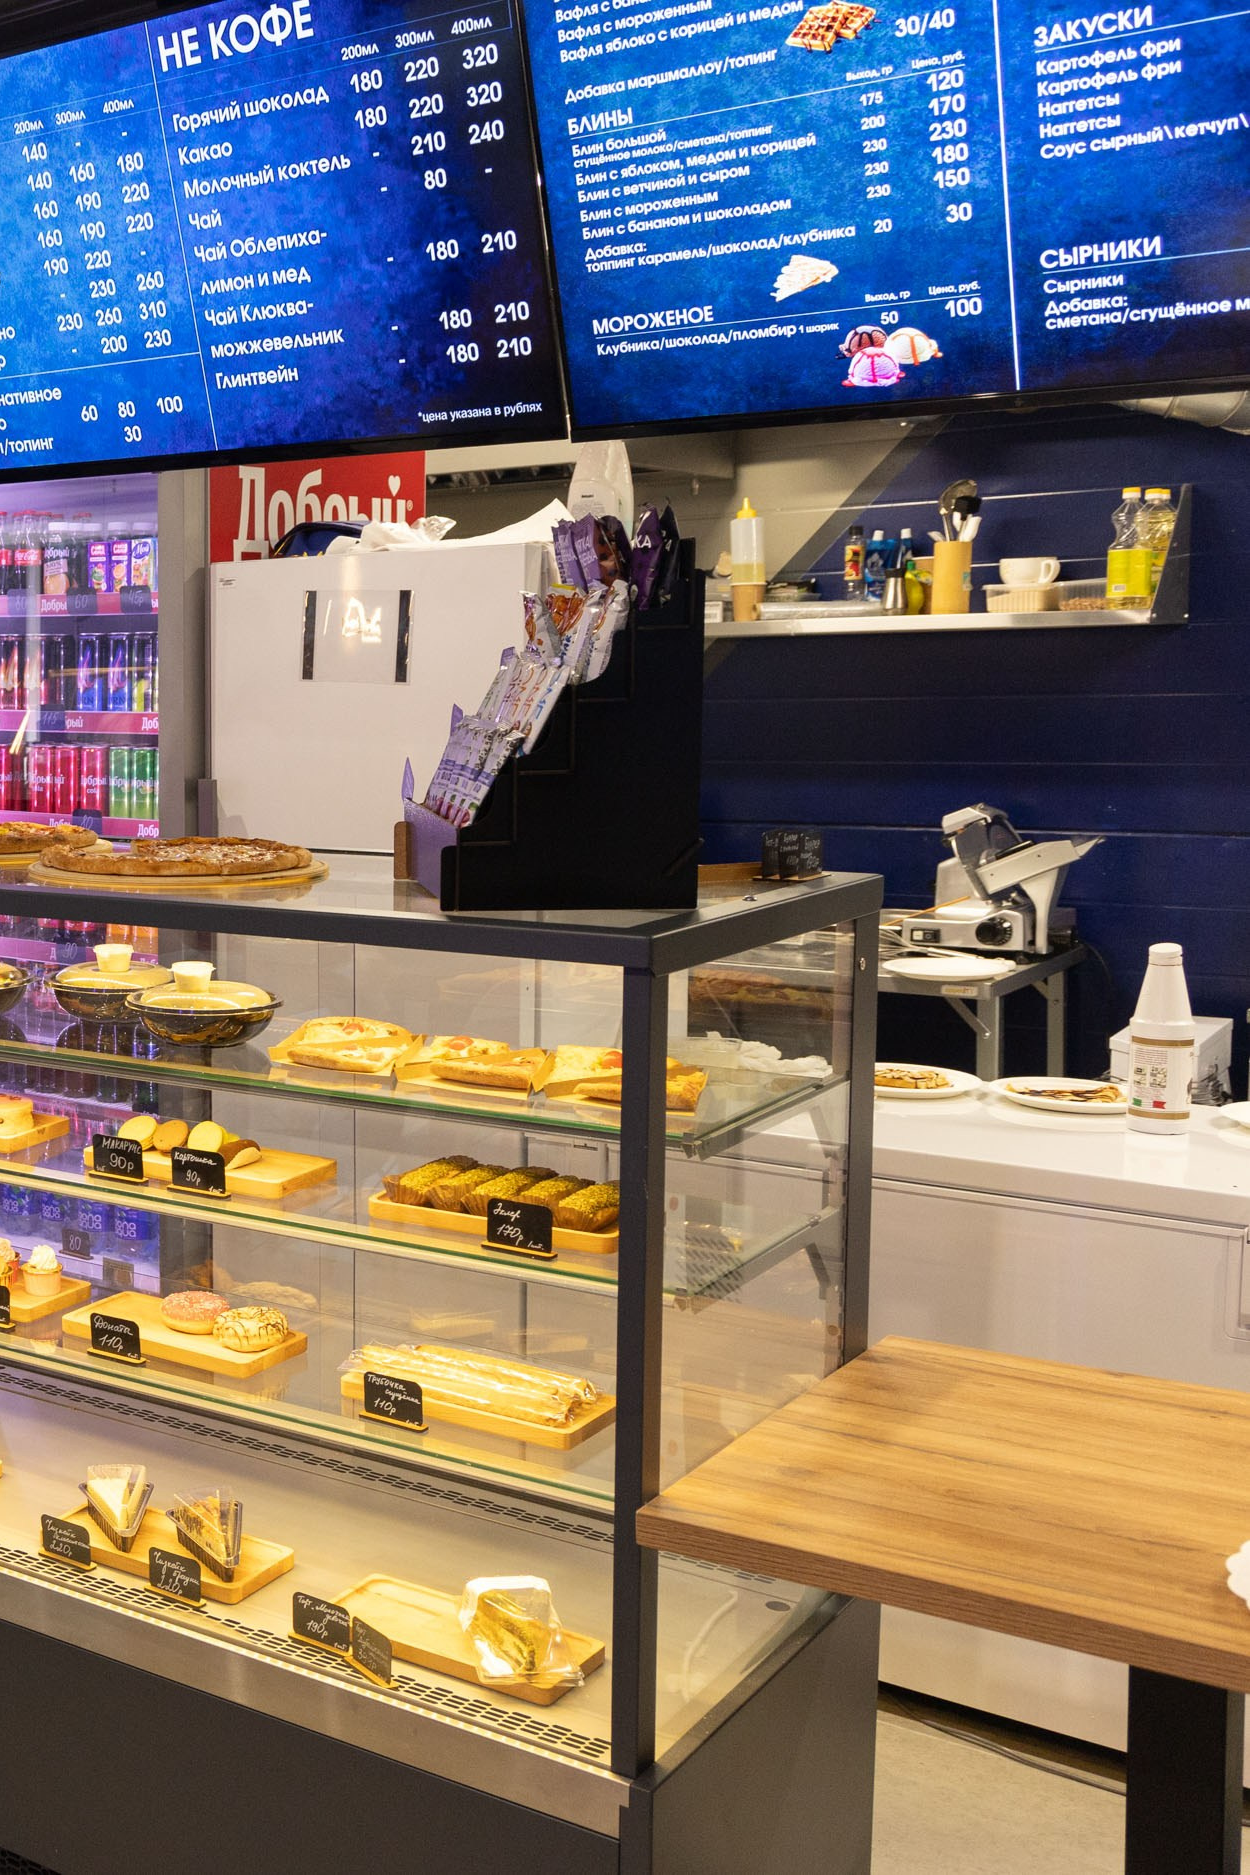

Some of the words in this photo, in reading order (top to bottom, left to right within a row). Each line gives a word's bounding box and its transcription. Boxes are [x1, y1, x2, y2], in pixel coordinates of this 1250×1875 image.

[157, 27, 202, 73] НЕ
[207, 0, 314, 60] КОФЕ
[340, 43, 380, 61] 200мл
[395, 30, 435, 49] 300мл
[450, 16, 493, 35] 400мл
[557, 23, 601, 43] Вафля
[602, 21, 613, 33] с
[615, 1, 712, 30] мороженным
[1033, 4, 1153, 48] ЗАКУСКИ
[564, 80, 626, 105] Добавка
[627, 48, 778, 90] маршмаллоу/топинг
[894, 8, 956, 38] 30/40
[1035, 47, 1138, 76] Картофель
[1140, 37, 1181, 60] фри
[172, 100, 241, 133] Горячий
[243, 86, 330, 117] шоколад
[349, 69, 383, 93] 180
[404, 56, 440, 83] 220
[462, 43, 499, 70] 320
[1038, 92, 1121, 118] Наггетсы
[567, 107, 634, 137] БЛИНЫ
[571, 142, 604, 158] Блин
[605, 127, 667, 152] большой
[859, 90, 884, 107] 175
[926, 68, 965, 92] 120
[21, 142, 48, 163] 140
[183, 164, 275, 199] Молочный
[277, 154, 351, 181] коктель
[411, 130, 446, 156] 210
[468, 119, 505, 145] 240
[574, 149, 631, 168] сгущённое
[632, 124, 773, 158] молоко/сметана/топпинг
[1040, 141, 1087, 159] Соус
[27, 170, 53, 192] 140
[69, 161, 96, 184] 160
[116, 151, 144, 174] 180
[579, 208, 612, 223] Блин
[613, 206, 623, 217] с
[626, 190, 718, 215] мороженным
[864, 160, 889, 177] 230
[931, 142, 969, 165] 180
[193, 241, 228, 263] Чай
[585, 257, 636, 273] топпинг
[638, 224, 856, 265] карамель/шоколад/клубника
[873, 218, 893, 234] 20
[945, 202, 973, 223] 30
[585, 242, 647, 261] Добавка:
[1039, 235, 1162, 271] СЫРНИКИ
[43, 257, 69, 277] 190
[84, 249, 112, 270] 220
[201, 274, 255, 296] лимон
[257, 272, 270, 287] и
[272, 266, 312, 285] мед
[425, 239, 459, 261] 180
[481, 230, 517, 254] 210
[89, 278, 116, 299] 230
[136, 270, 165, 292] 260
[1043, 274, 1124, 294] Сырники
[204, 306, 238, 327] Чай
[592, 305, 714, 336] МОРОЖЕНОЕ
[1044, 294, 1128, 317] Добавка:
[1044, 295, 1232, 330] сметана/сгущённое
[100, 334, 128, 354] 200
[143, 328, 172, 349] 230
[210, 328, 345, 359] можжевельник
[438, 308, 472, 330] 180
[494, 301, 530, 324] 210
[596, 324, 796, 355] Клубника/шоколад/пломбир
[798, 324, 804, 334] 1
[805, 322, 840, 333] шарик
[880, 310, 899, 325] 50
[946, 298, 982, 317] 100
[215, 364, 299, 390] Глинтвейн
[446, 342, 480, 364] 180
[496, 336, 532, 358] 210
[80, 404, 99, 422] 60
[117, 400, 136, 418] 80
[156, 395, 183, 414] 100
[449, 407, 492, 422] указана
[494, 406, 502, 416] в
[503, 402, 543, 417] рублях
[123, 425, 142, 443] 30
[40, 599, 68, 613] Добры
[137, 823, 159, 838] Добр
